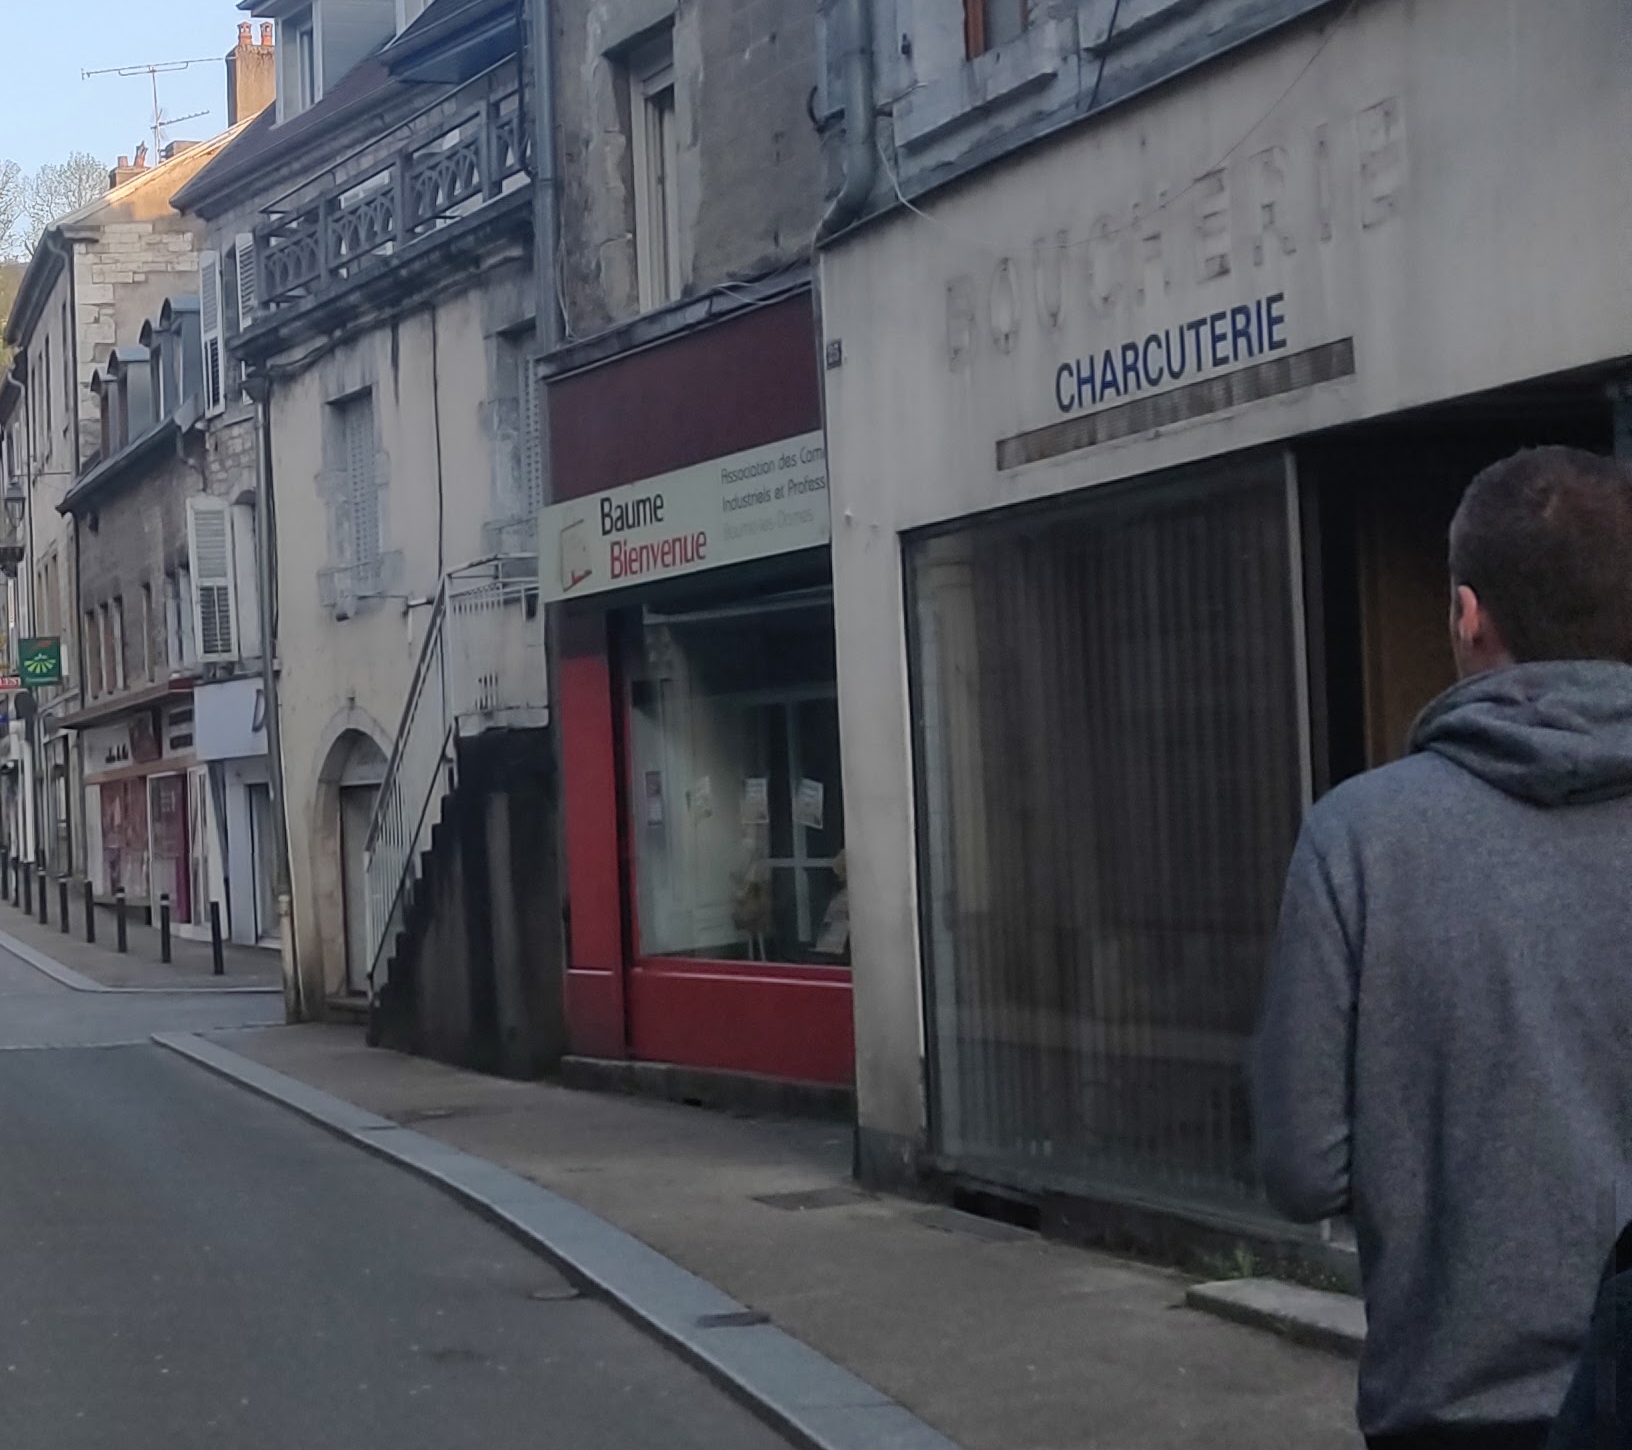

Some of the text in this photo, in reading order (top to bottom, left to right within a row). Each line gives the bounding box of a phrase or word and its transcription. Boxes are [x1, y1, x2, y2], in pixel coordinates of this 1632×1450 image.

[1055, 292, 1288, 414] CHARCUTERIE
[721, 460, 775, 485] Association
[778, 453, 797, 470] des
[600, 493, 664, 536] Baume
[722, 486, 772, 512] Industriels
[774, 485, 785, 500] et
[610, 531, 707, 580] Bienvenue
